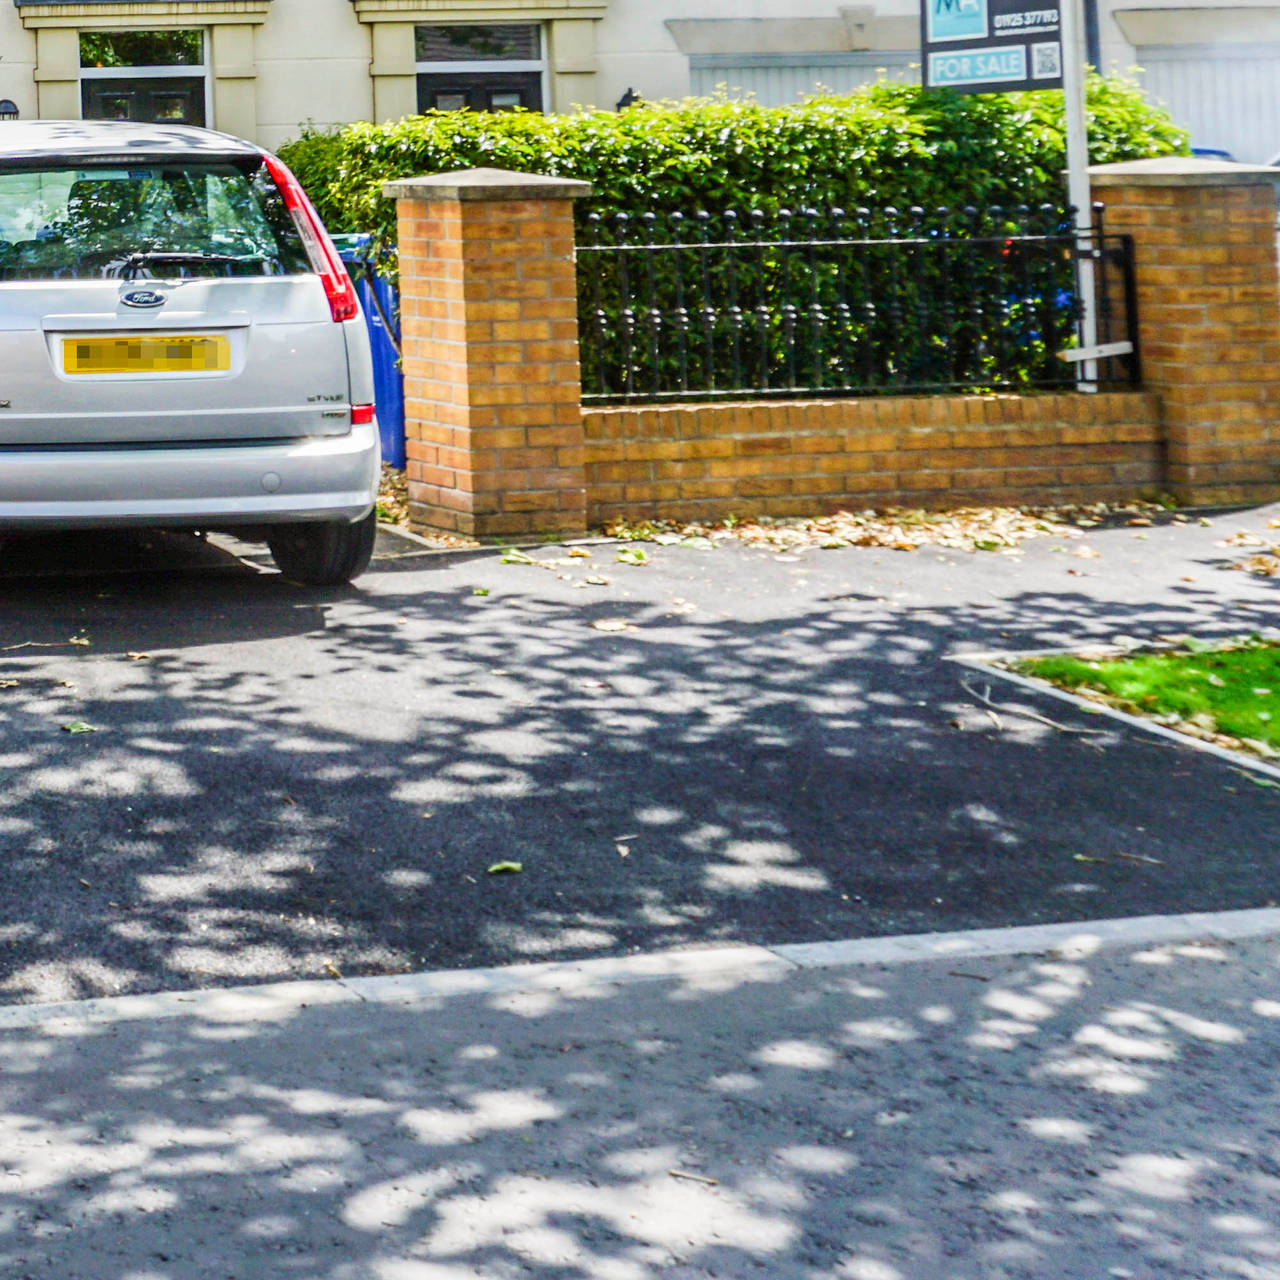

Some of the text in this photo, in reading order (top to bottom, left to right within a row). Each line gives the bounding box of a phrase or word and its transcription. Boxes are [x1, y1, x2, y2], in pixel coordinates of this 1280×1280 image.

[935, 52, 1020, 80] FOR SALE
[132, 292, 156, 303] Ford
